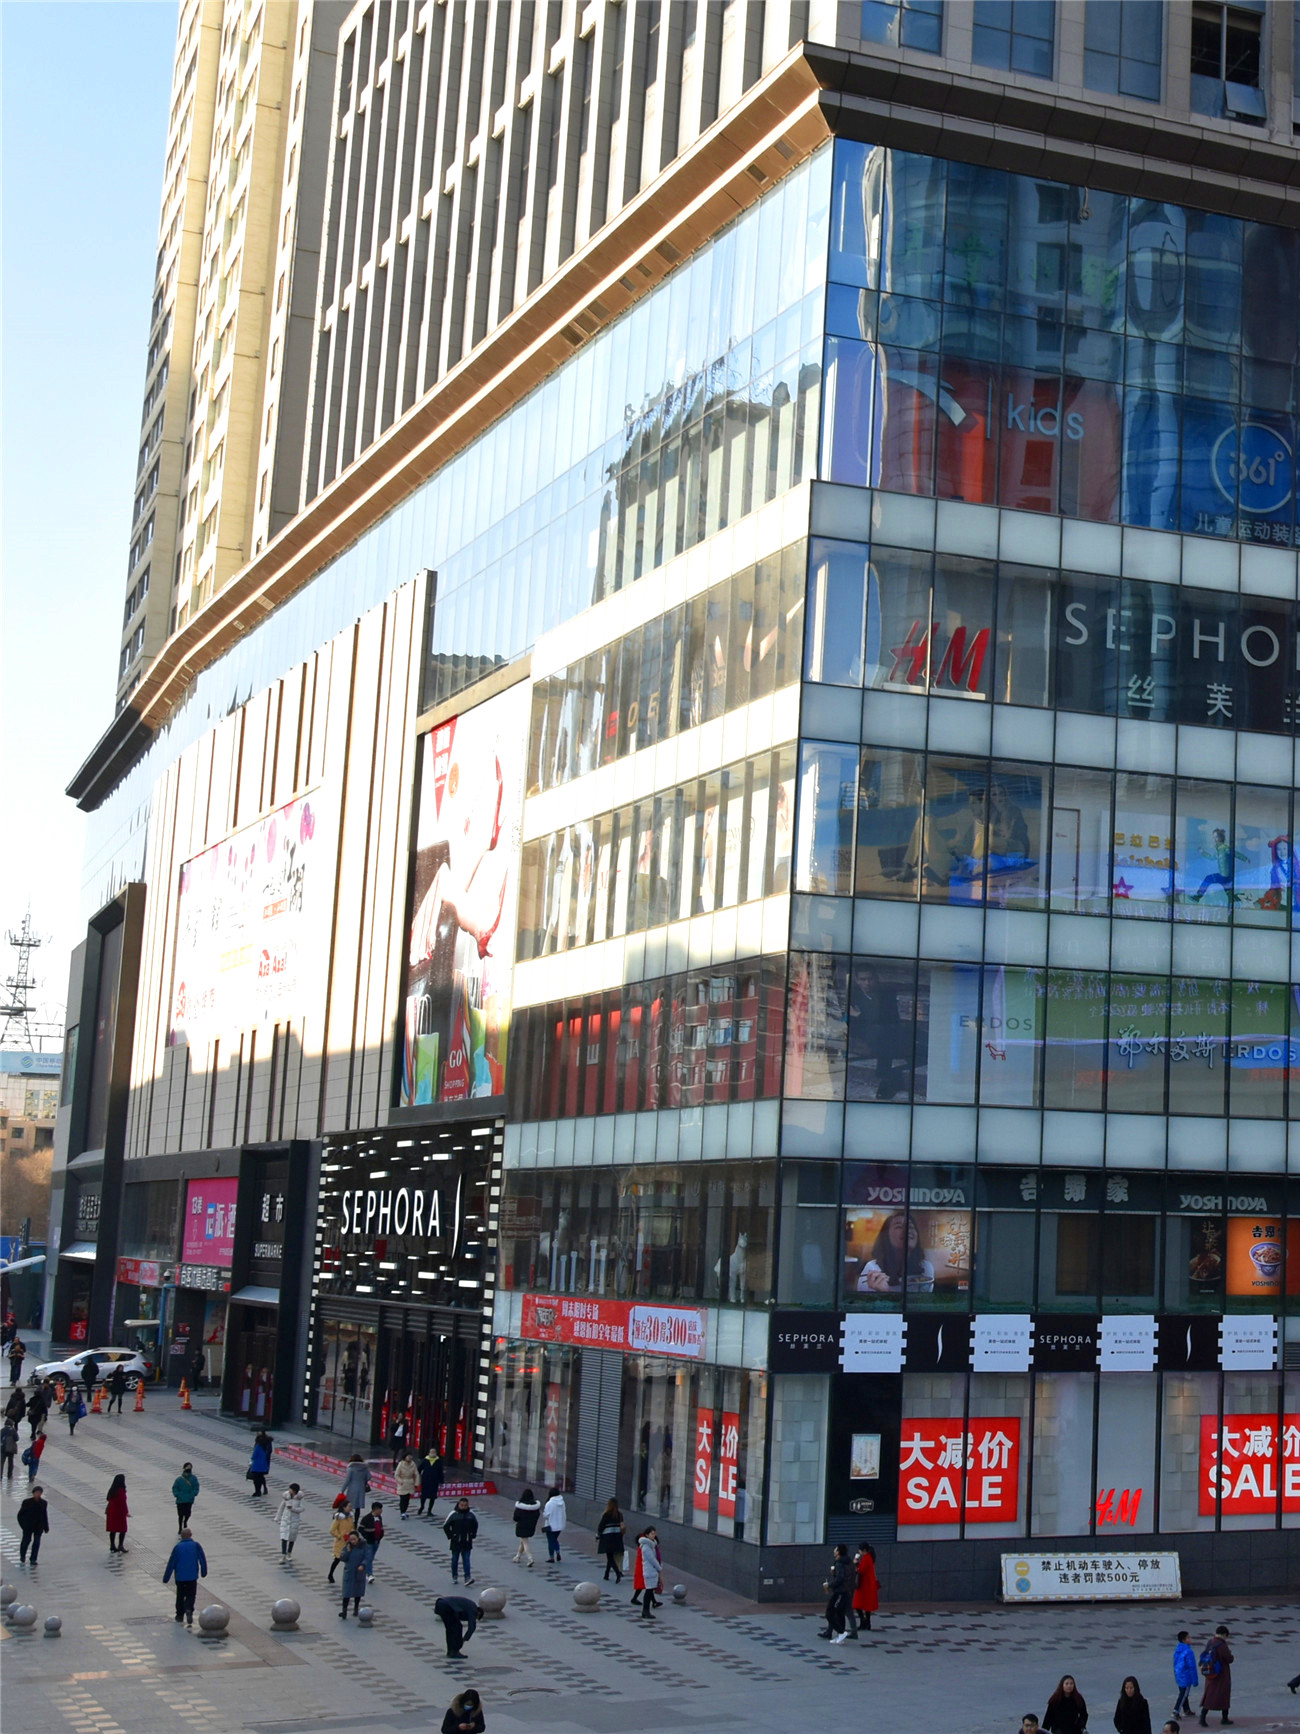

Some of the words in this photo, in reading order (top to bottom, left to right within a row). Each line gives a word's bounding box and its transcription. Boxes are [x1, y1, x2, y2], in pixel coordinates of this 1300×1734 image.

[1007, 392, 1085, 440] kids
[959, 1015, 1033, 1031] ERDOS
[450, 1049, 463, 1069] GO
[867, 1187, 966, 1204] YOSHINOYA
[1179, 1194, 1268, 1212] YOSHNOYA
[260, 1192, 285, 1223] 超市
[340, 1187, 441, 1238] SEPHORA
[254, 1243, 283, 1259] SUPERMARKE
[778, 1333, 835, 1343] SEPHORA
[1039, 1335, 1092, 1344] SEPHORA
[698, 1420, 739, 1459] 大价
[899, 1431, 1014, 1470] 大减价
[906, 1475, 1003, 1510] SALE
[1041, 1559, 1161, 1571] 禁止机动车驶入、停放
[1059, 1572, 1140, 1584] 违者罚款500元
